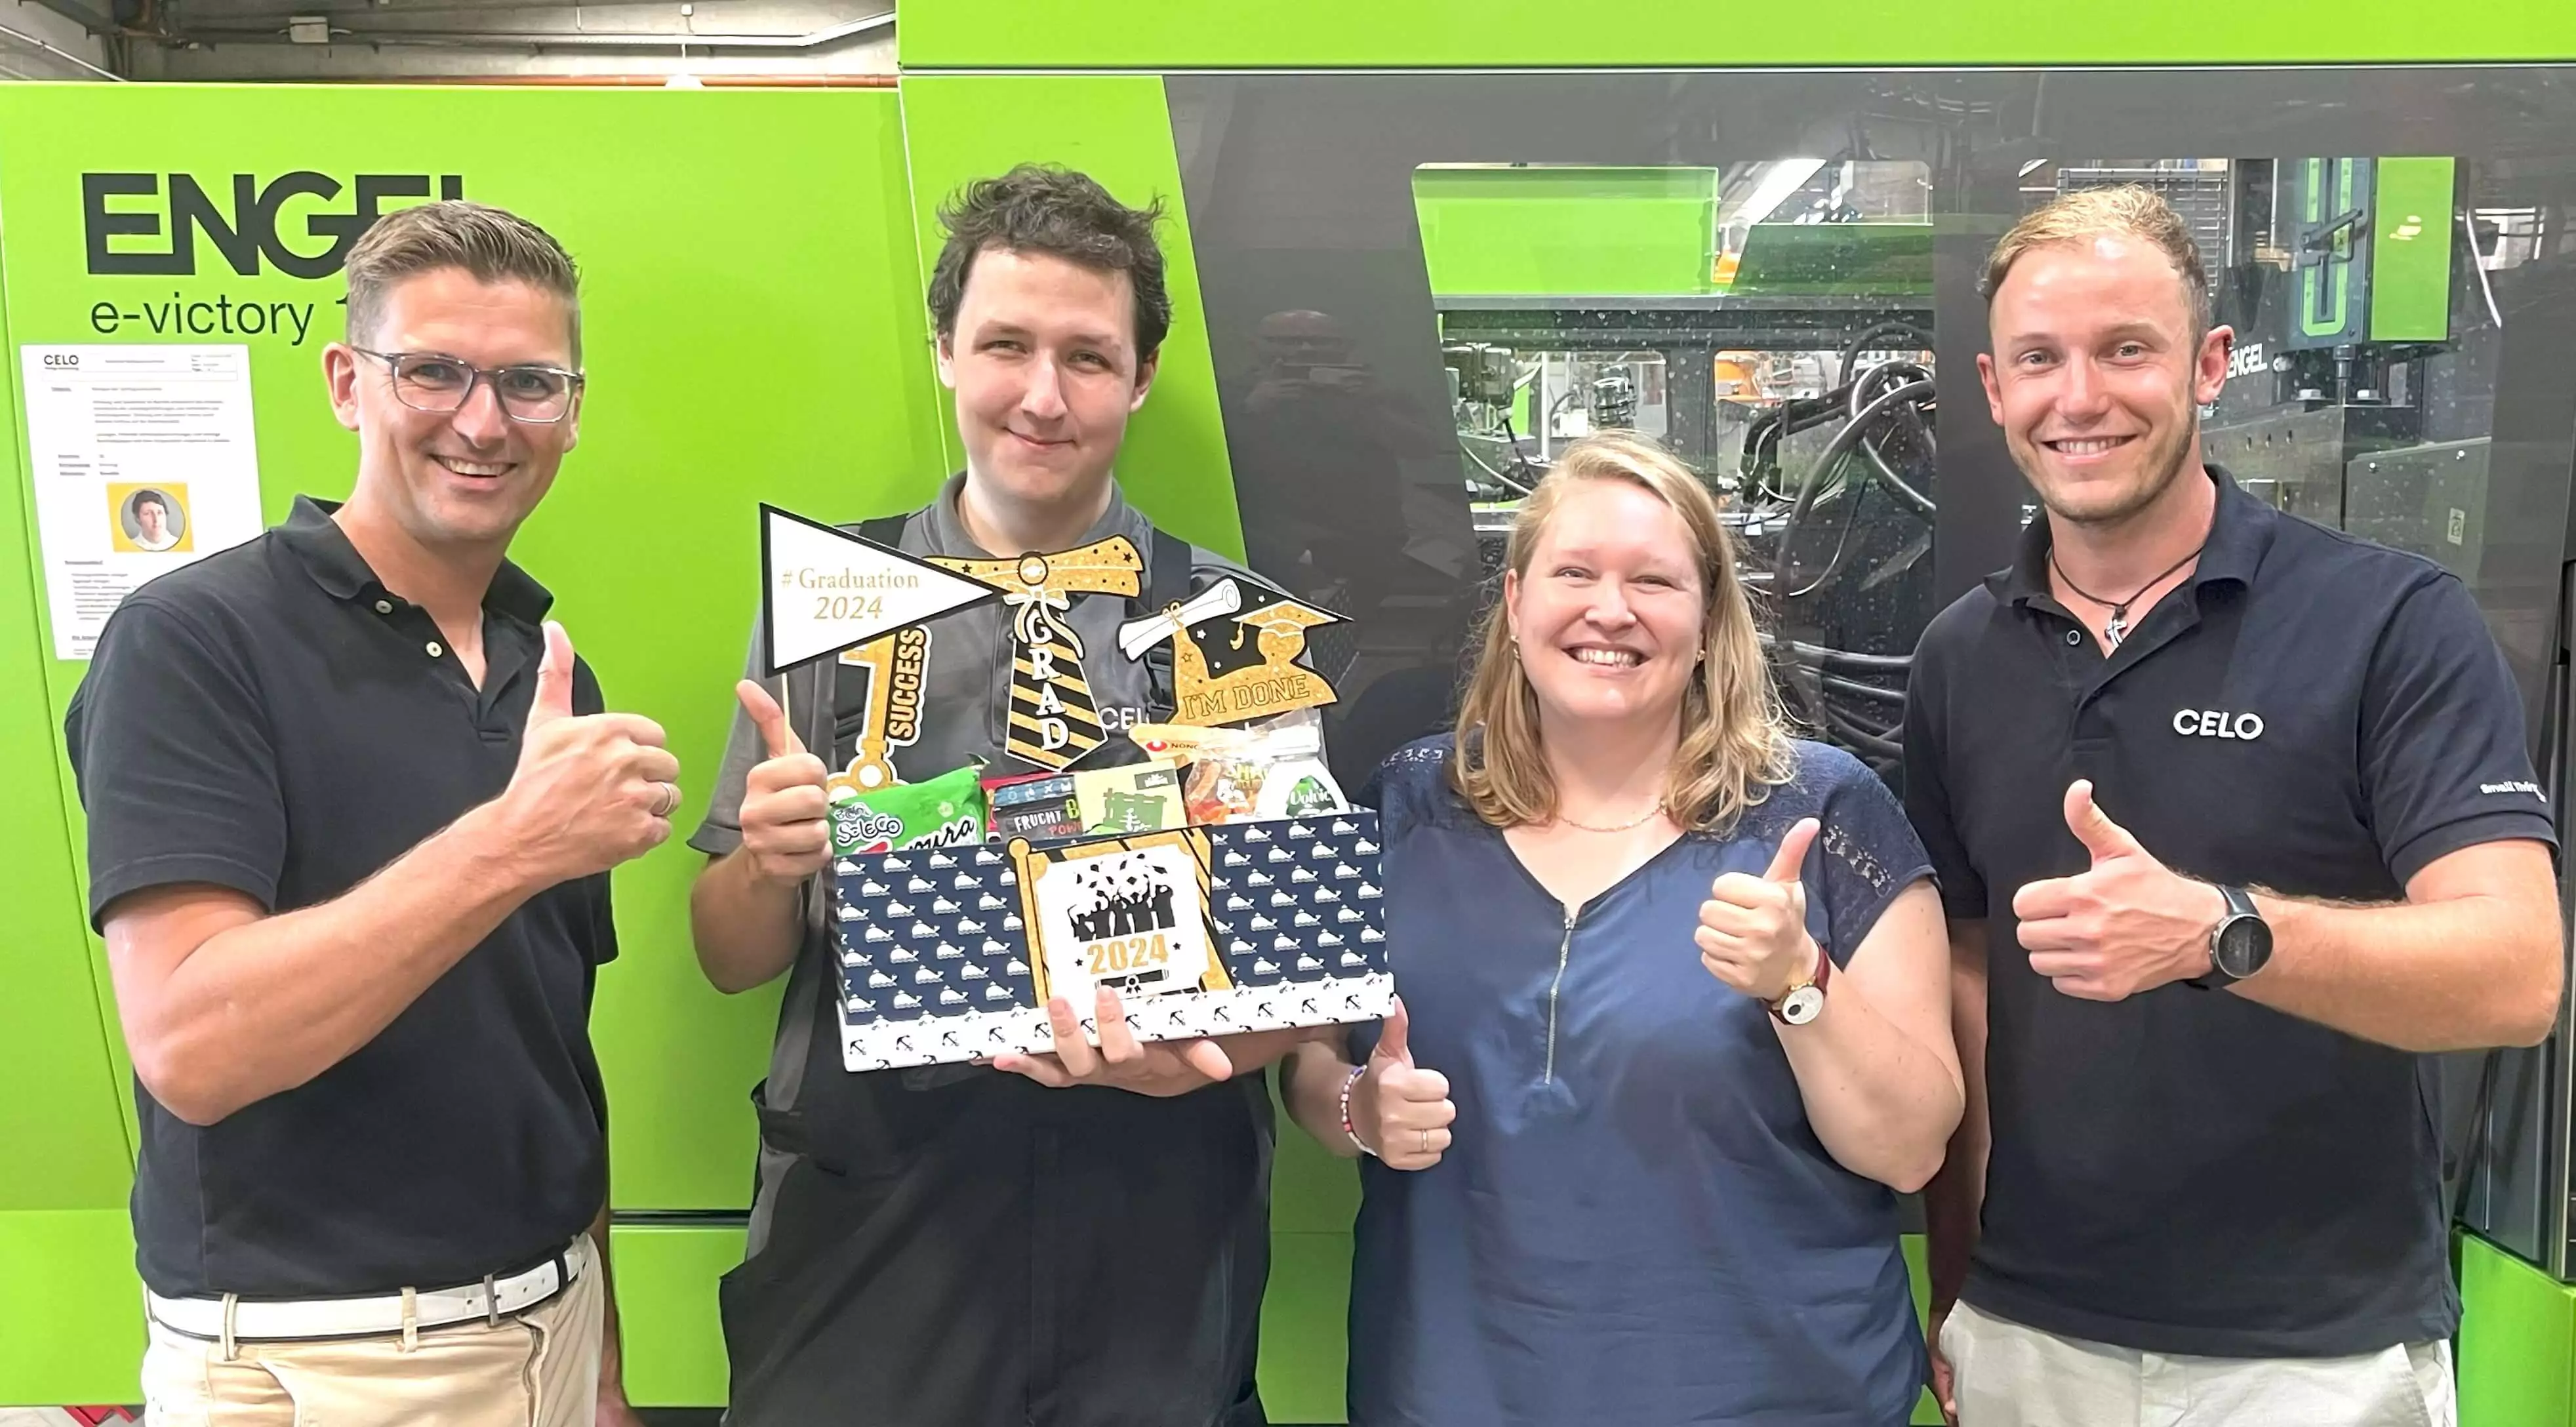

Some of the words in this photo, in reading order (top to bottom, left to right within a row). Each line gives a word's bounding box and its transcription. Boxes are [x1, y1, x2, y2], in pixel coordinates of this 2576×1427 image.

[82, 171, 462, 279] ENGE
[91, 292, 315, 346] e-victory
[43, 355, 79, 365] CELO
[2226, 343, 2268, 379] ENGEL
[814, 595, 883, 620] 2024
[888, 628, 925, 738] SUCCESS
[1026, 609, 1069, 751] GRAD
[1183, 690, 1227, 720] I'M
[1233, 674, 1310, 710] DONE
[1100, 707, 1150, 730] CEL
[2173, 708, 2264, 740] CELO
[1014, 810, 1062, 833] FRUCHT
[1087, 934, 1169, 975] 2024
